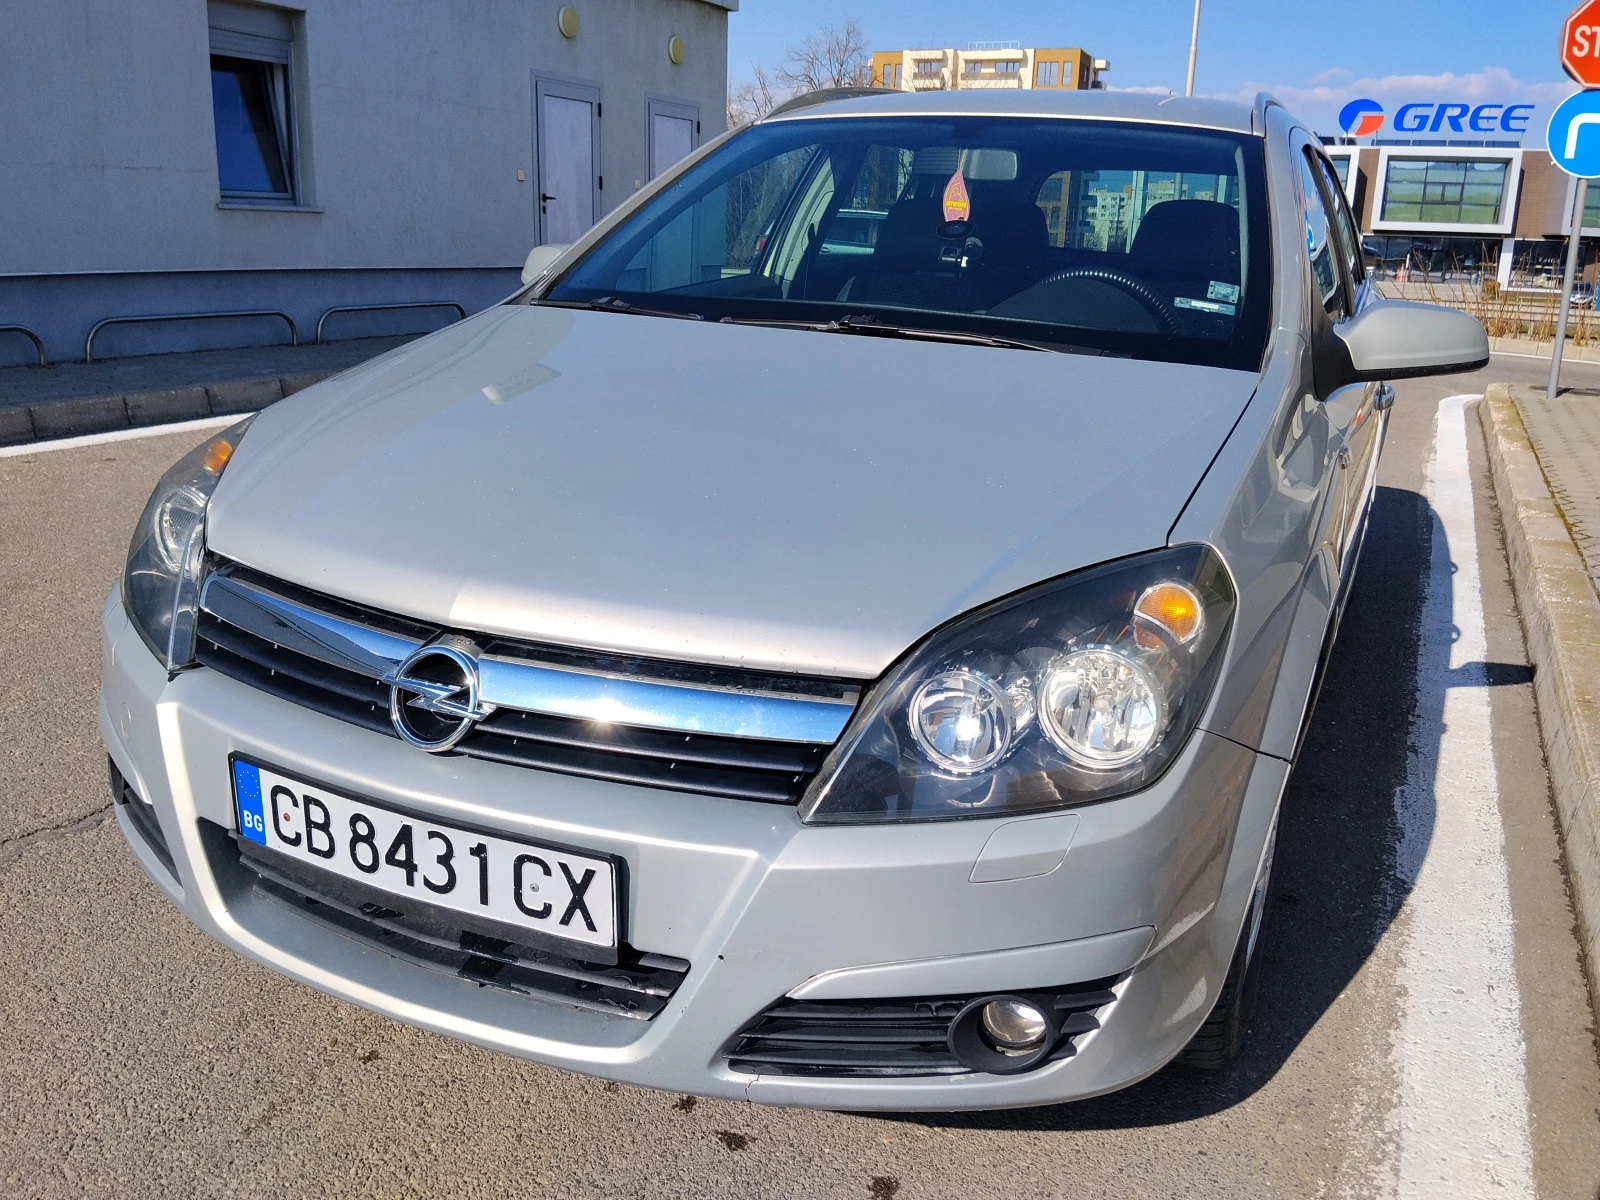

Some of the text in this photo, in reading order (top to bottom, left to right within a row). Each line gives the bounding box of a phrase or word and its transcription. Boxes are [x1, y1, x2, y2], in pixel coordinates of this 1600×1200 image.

[1393, 103, 1535, 132] GREE
[243, 809, 263, 832] BG
[271, 784, 598, 932] CB 8431 CX
